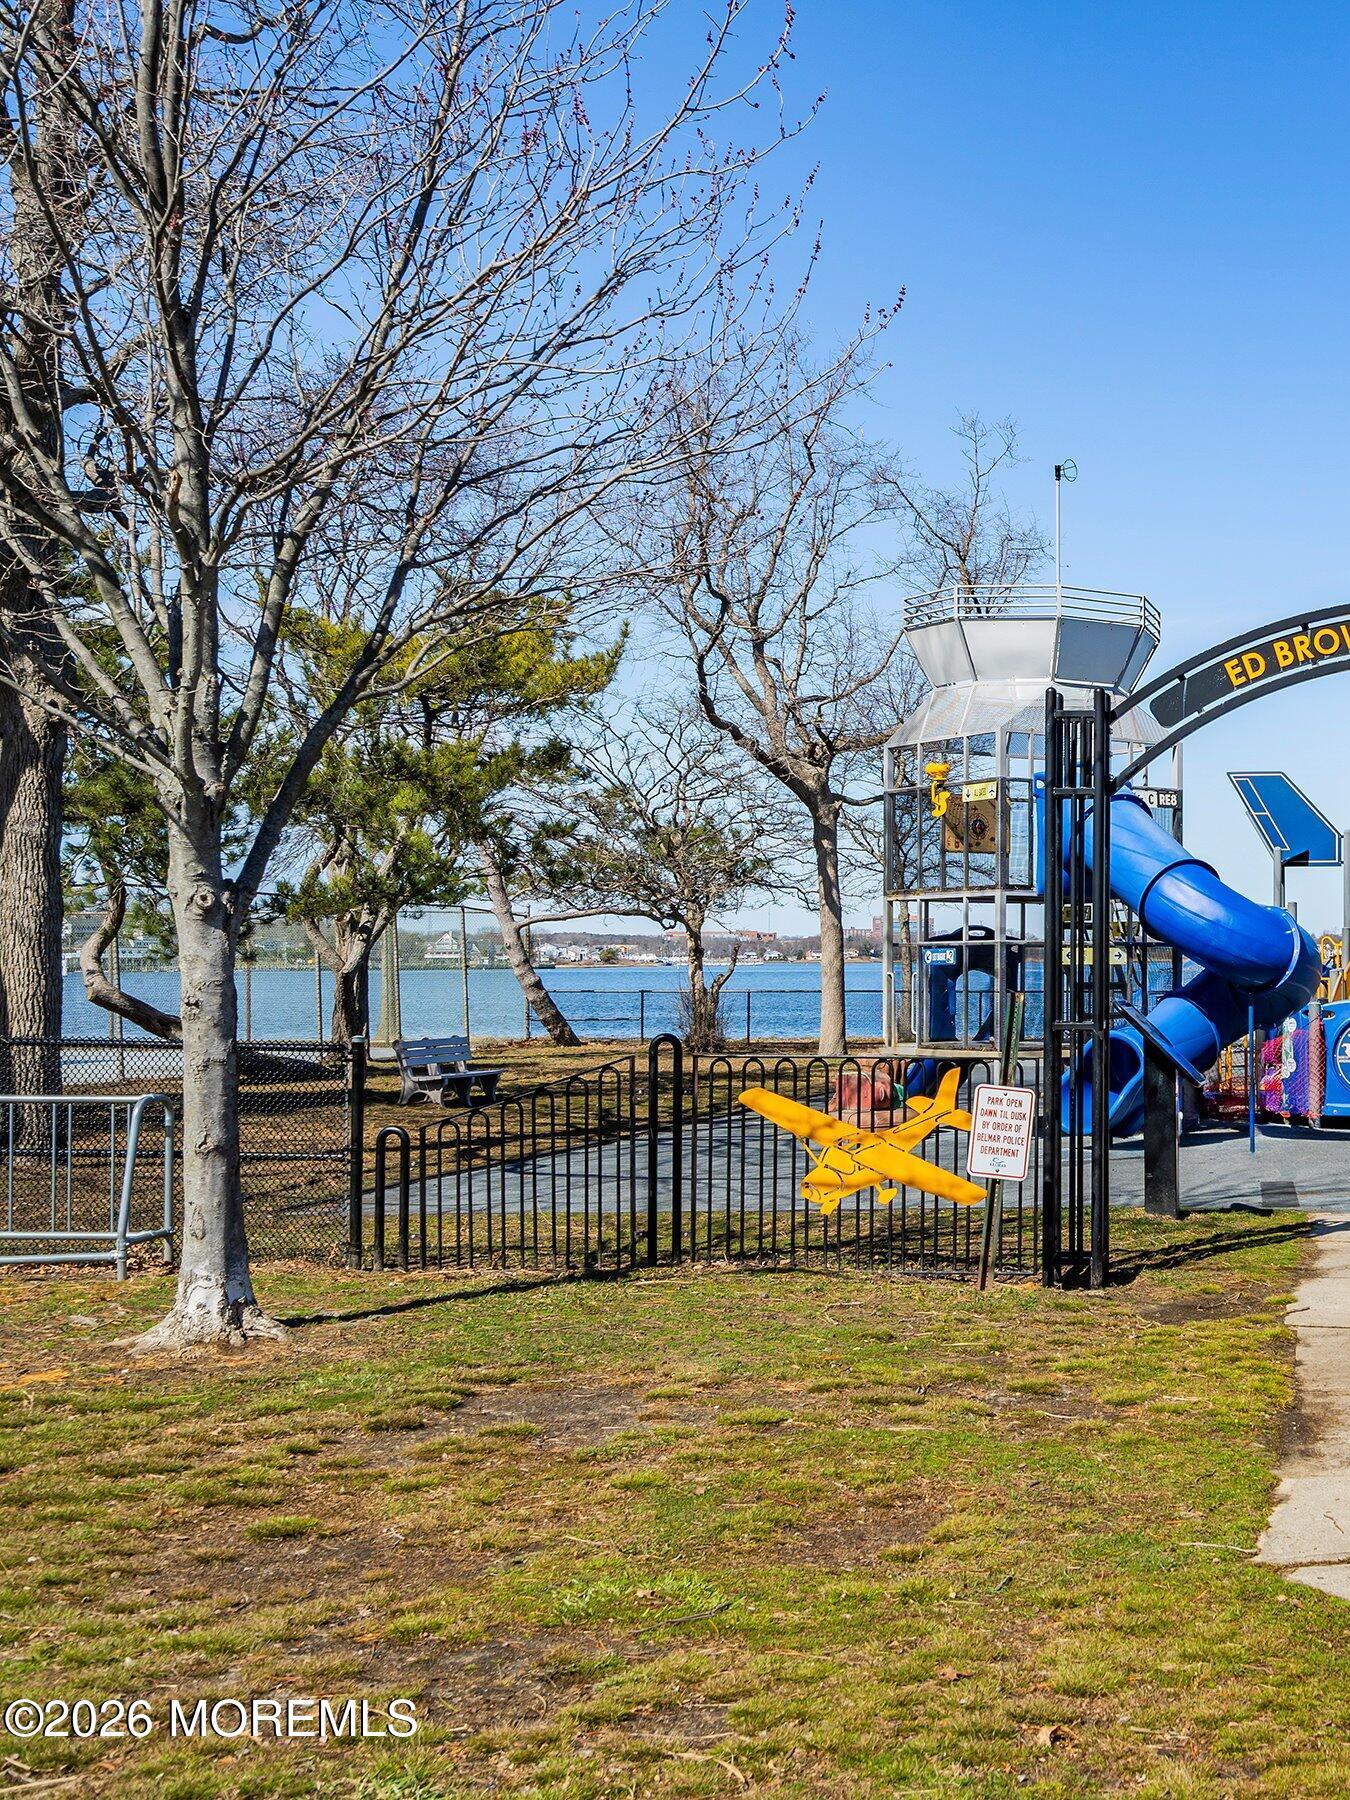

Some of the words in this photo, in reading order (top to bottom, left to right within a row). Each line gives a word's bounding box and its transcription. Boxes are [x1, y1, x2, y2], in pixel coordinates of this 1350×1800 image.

[1223, 651, 1267, 689] ED
[987, 1096, 1004, 1106] PARK
[1006, 1098, 1023, 1108] OPEN
[980, 1108, 997, 1118] DAWN
[999, 1110, 1008, 1119] TIL
[1011, 1112, 1027, 1121] DUSK
[982, 1121, 990, 1130] BY
[992, 1122, 1013, 1132] ORDER
[1014, 1124, 1022, 1133] OF
[977, 1133, 1001, 1142] BELMAR
[1002, 1135, 1025, 1146] POLICE
[980, 1145, 1019, 1157] DEPARTMENT
